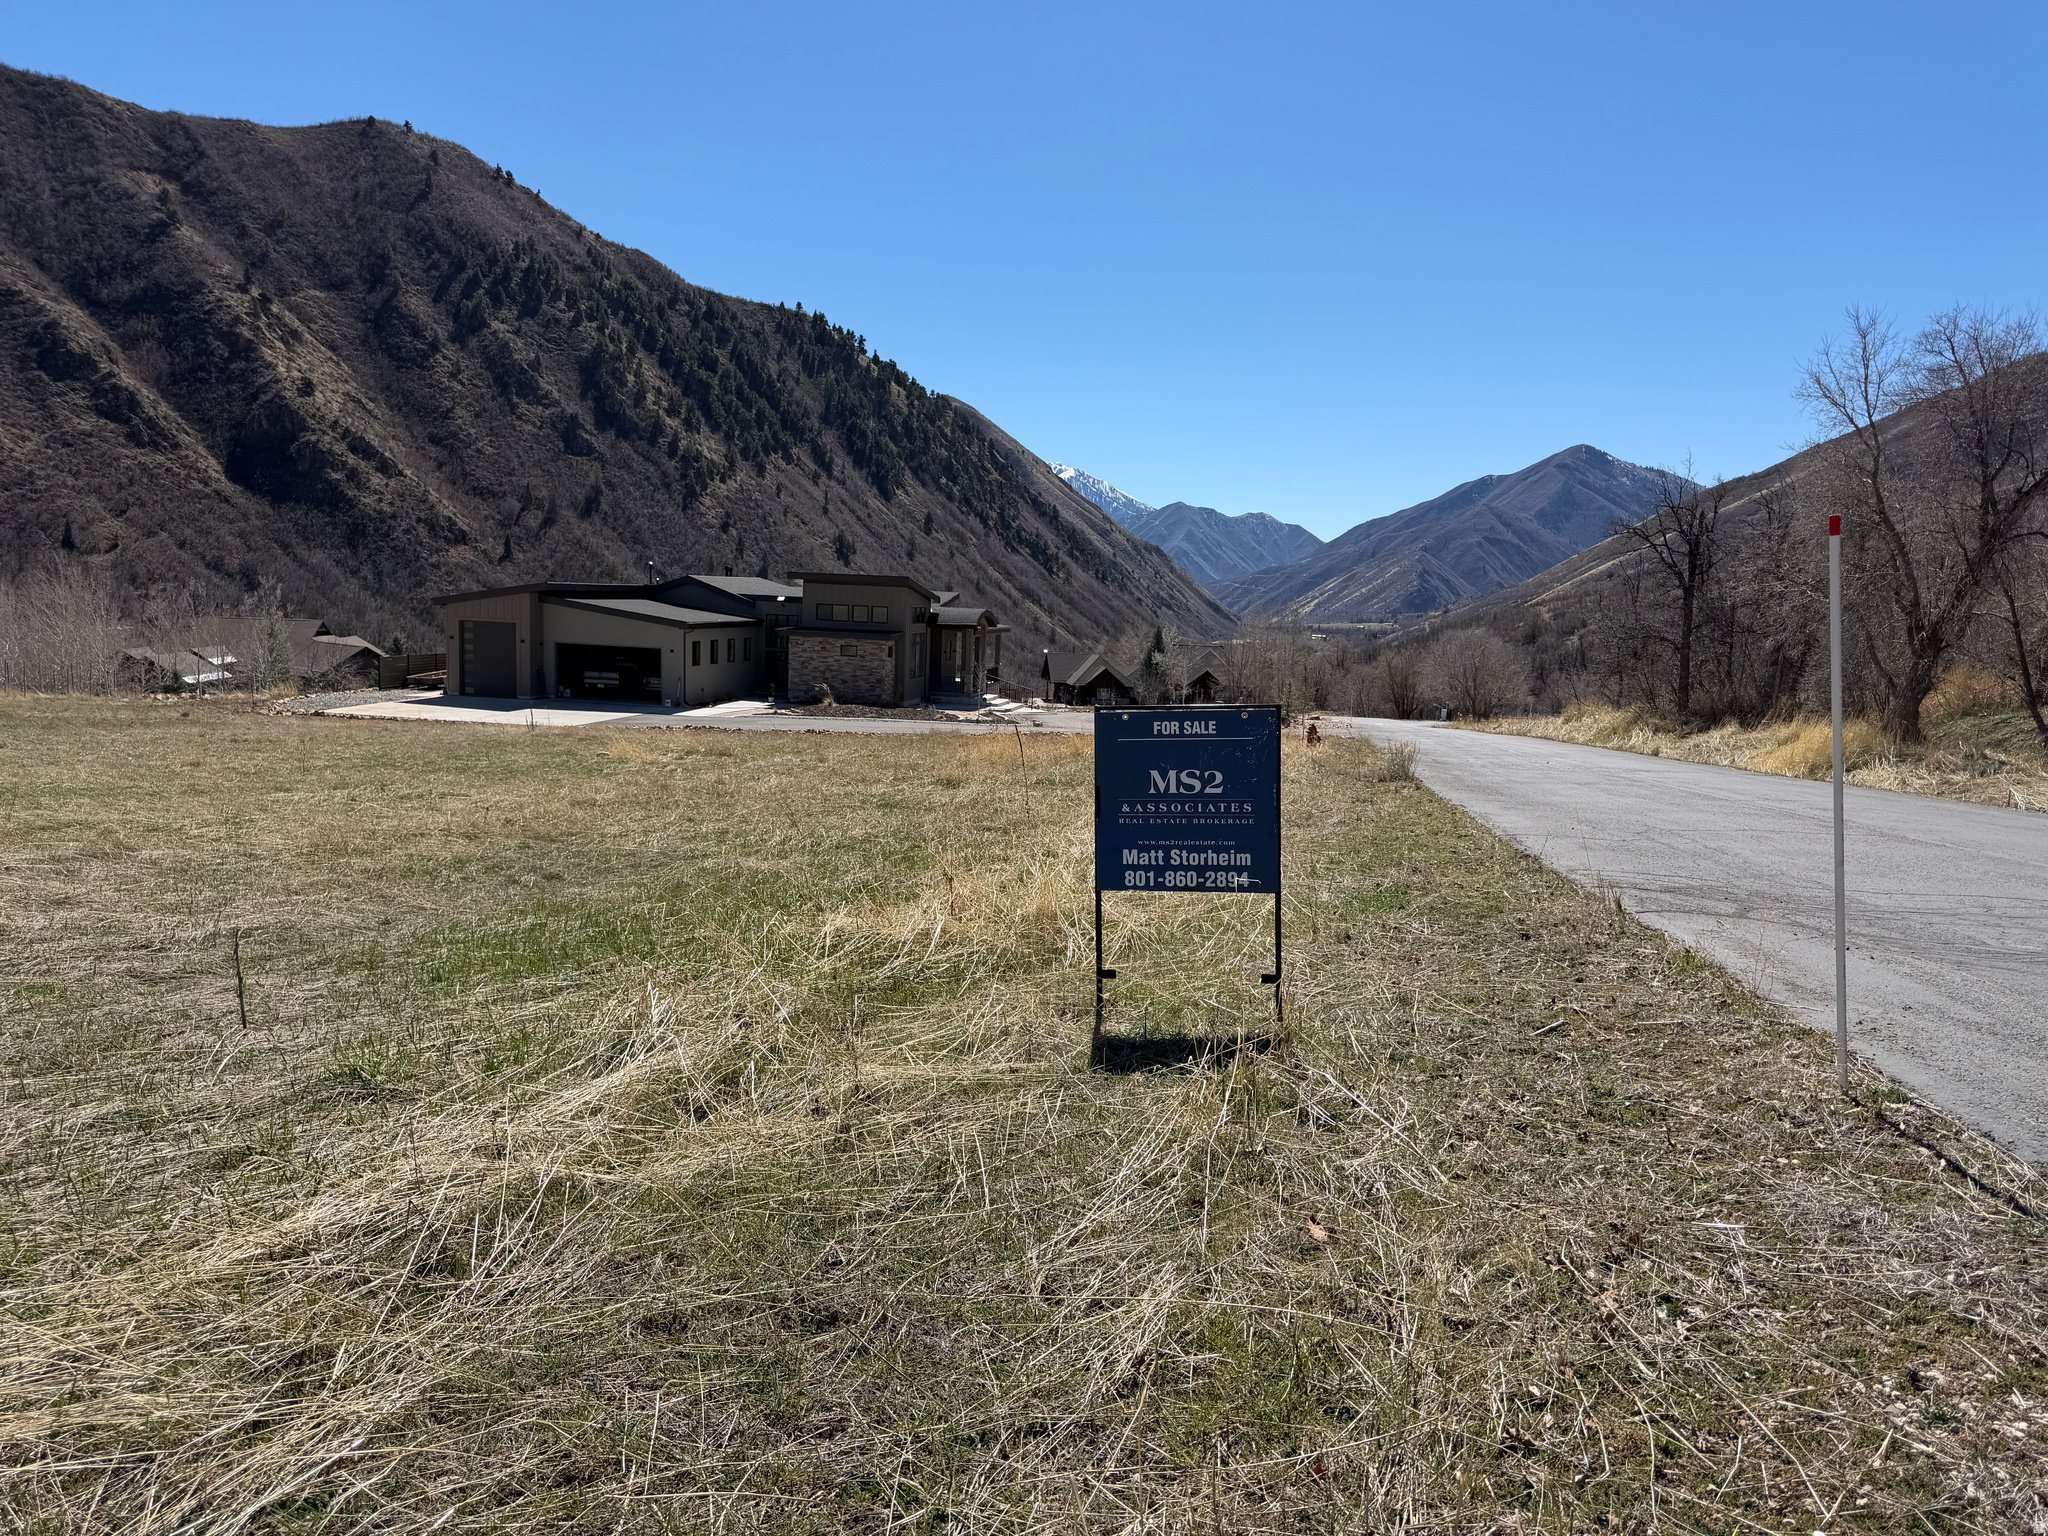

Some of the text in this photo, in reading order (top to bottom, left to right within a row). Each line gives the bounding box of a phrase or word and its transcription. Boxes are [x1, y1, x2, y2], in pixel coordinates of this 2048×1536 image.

[1153, 720, 1217, 735] FOR SALE
[1148, 769, 1224, 794] MS2
[1122, 849, 1252, 866] Matt Storheim
[1124, 870, 1250, 888] 801-860-2894
